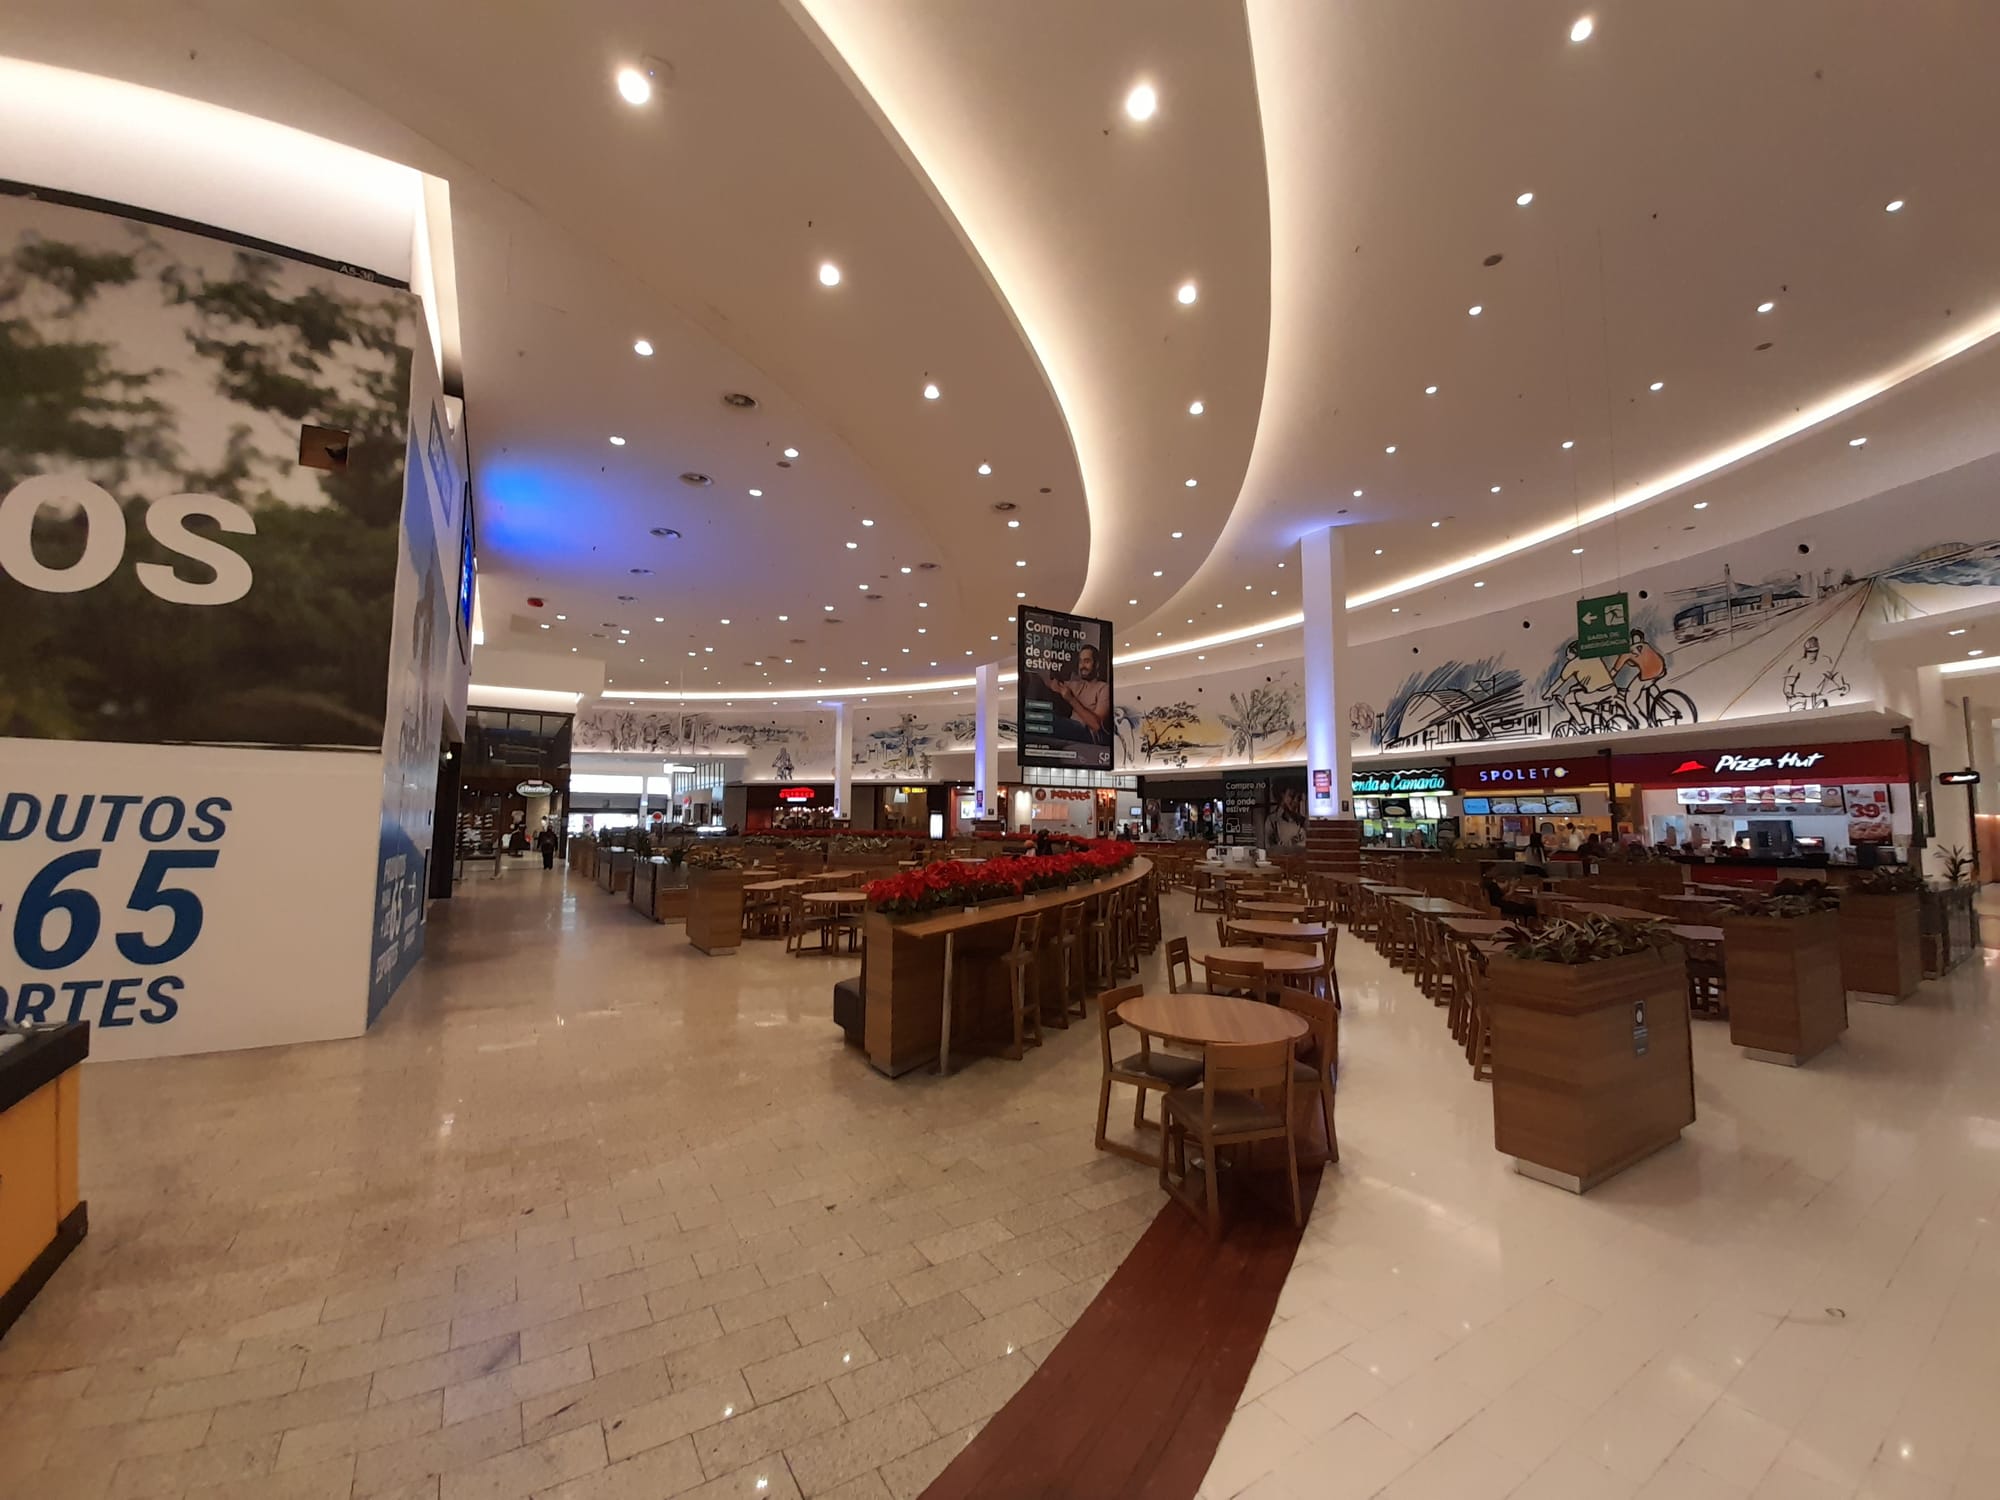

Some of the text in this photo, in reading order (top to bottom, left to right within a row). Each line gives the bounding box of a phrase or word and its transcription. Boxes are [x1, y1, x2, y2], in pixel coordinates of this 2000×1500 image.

[0, 473, 256, 606] OS
[1025, 620, 1087, 640] Compre no
[1025, 632, 1081, 652] SP Market
[1025, 644, 1071, 662] de onde
[1025, 657, 1063, 672] estiver
[1714, 752, 1825, 774] Pizza Hut
[1225, 781, 1267, 792] Compre no
[1390, 773, 1445, 791] Camarão
[1225, 796, 1256, 806] de onde
[0, 792, 233, 843] DUTOS
[1850, 803, 1880, 819] 39
[13, 848, 221, 971] 65
